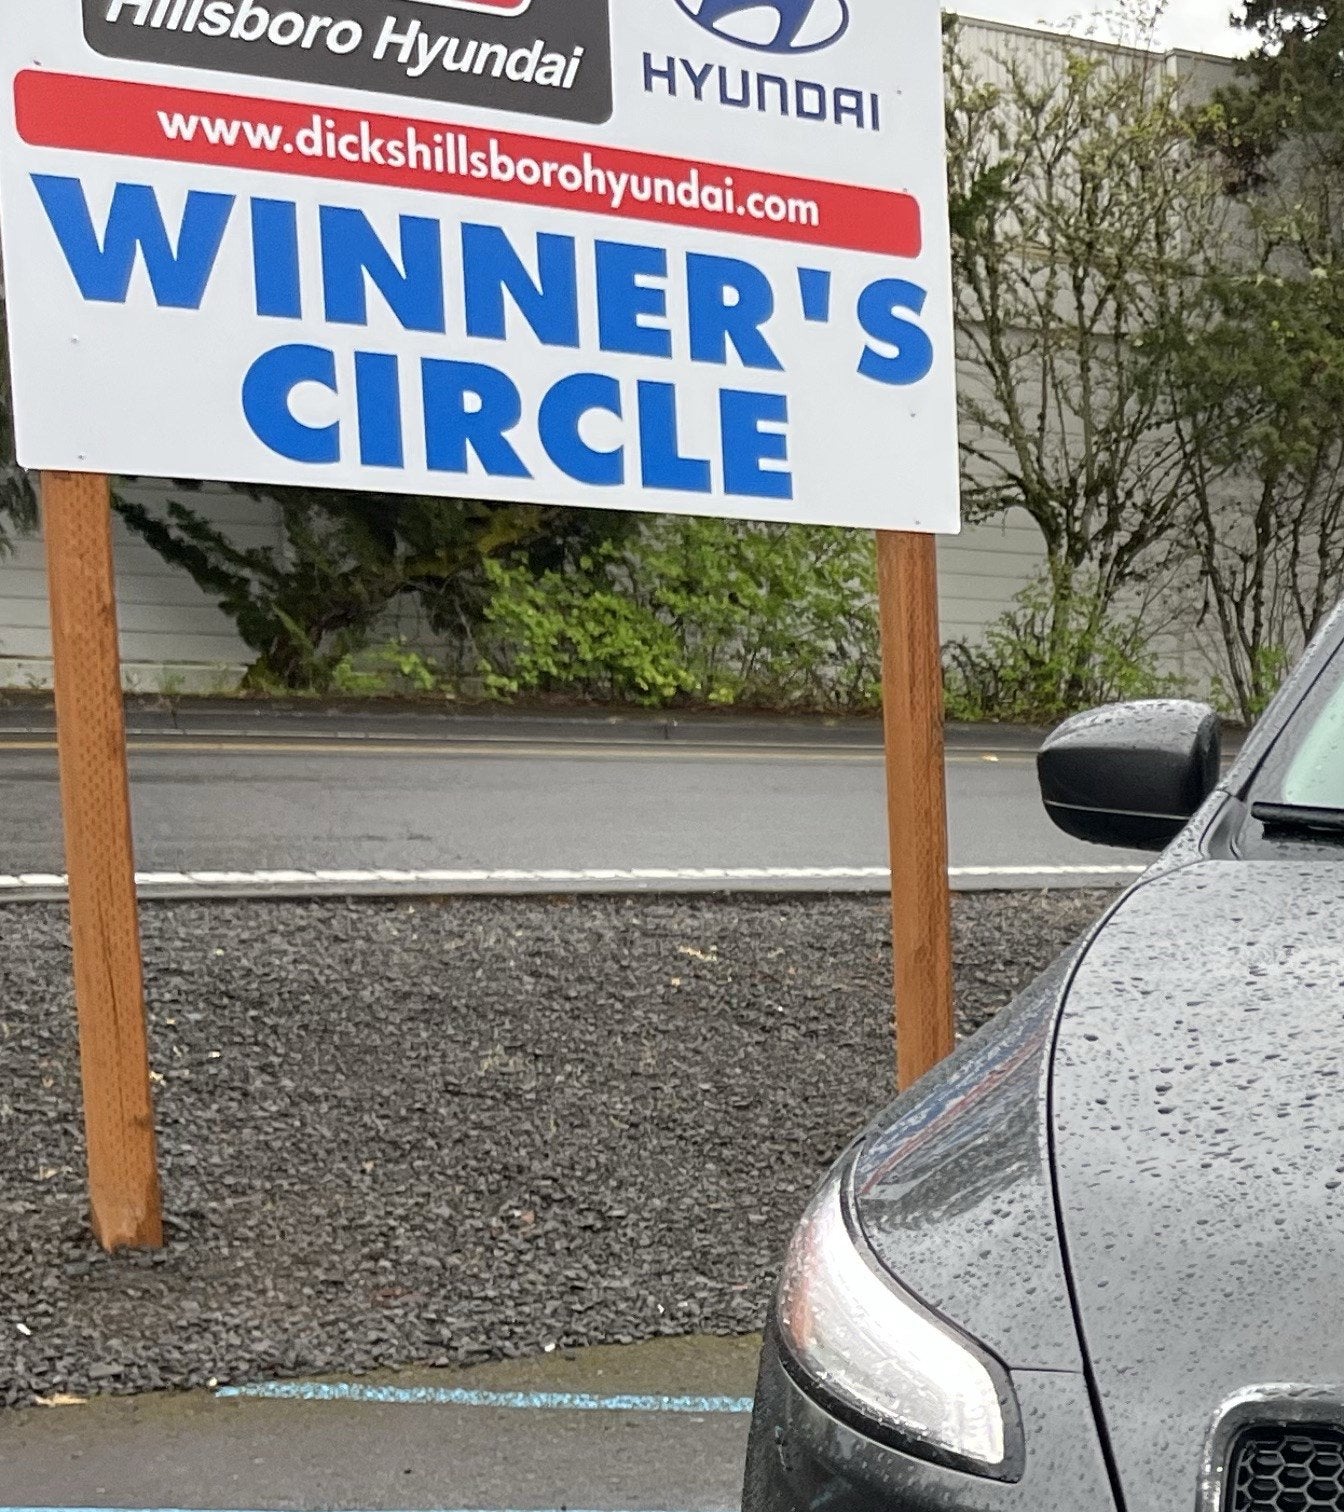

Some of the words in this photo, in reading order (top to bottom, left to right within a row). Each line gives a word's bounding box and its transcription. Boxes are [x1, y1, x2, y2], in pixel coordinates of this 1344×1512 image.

[372, 15, 585, 89] Hyundai
[642, 51, 880, 131] HYUNDAI
[156, 110, 821, 229] www.dickshillsborohyundai.com
[31, 173, 934, 386] WINNER'S
[241, 343, 793, 499] CIRCLE
